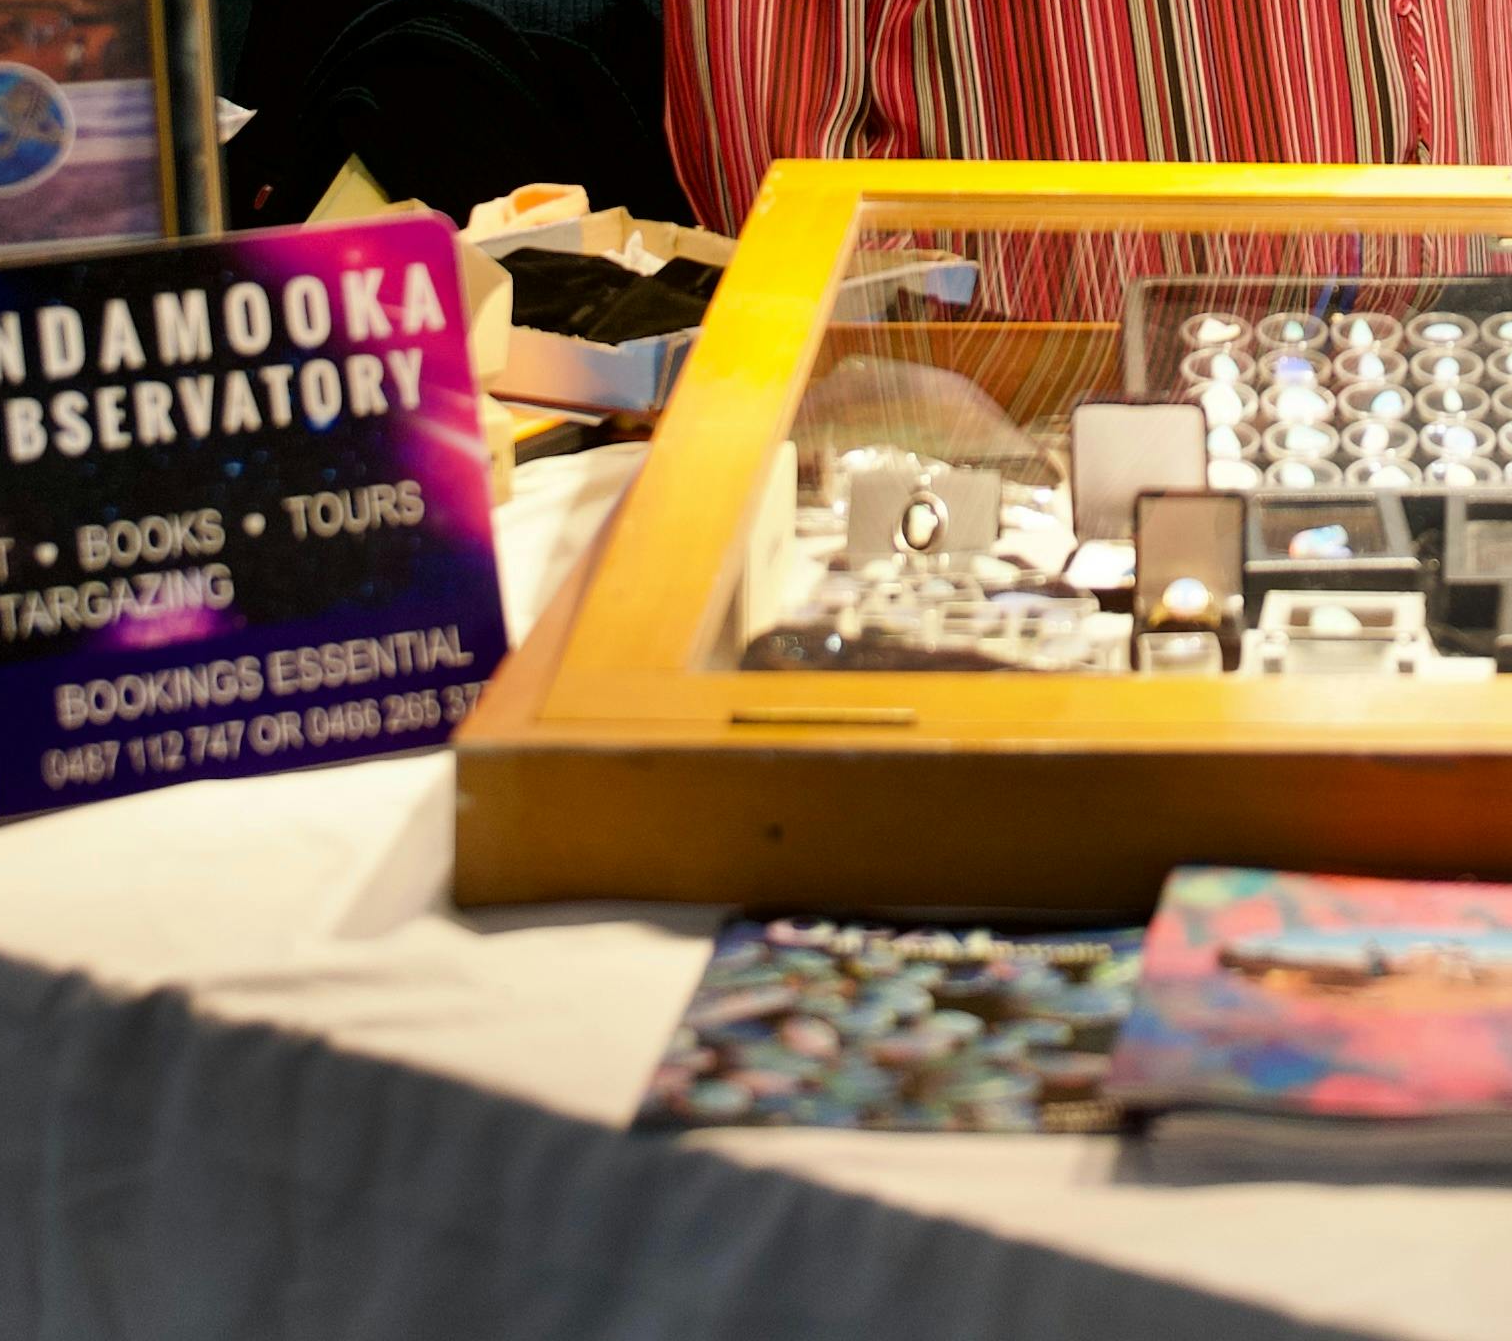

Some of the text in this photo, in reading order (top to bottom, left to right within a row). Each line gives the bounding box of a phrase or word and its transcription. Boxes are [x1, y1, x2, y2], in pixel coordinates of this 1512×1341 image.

[74, 508, 228, 572] BOOKS
[282, 479, 426, 541] TOURS
[53, 624, 475, 731] BOOKINGS ESSENTIAL
[125, 729, 186, 775] 112
[186, 719, 246, 766] 747
[246, 711, 305, 755] OR
[439, 679, 492, 725] 37
